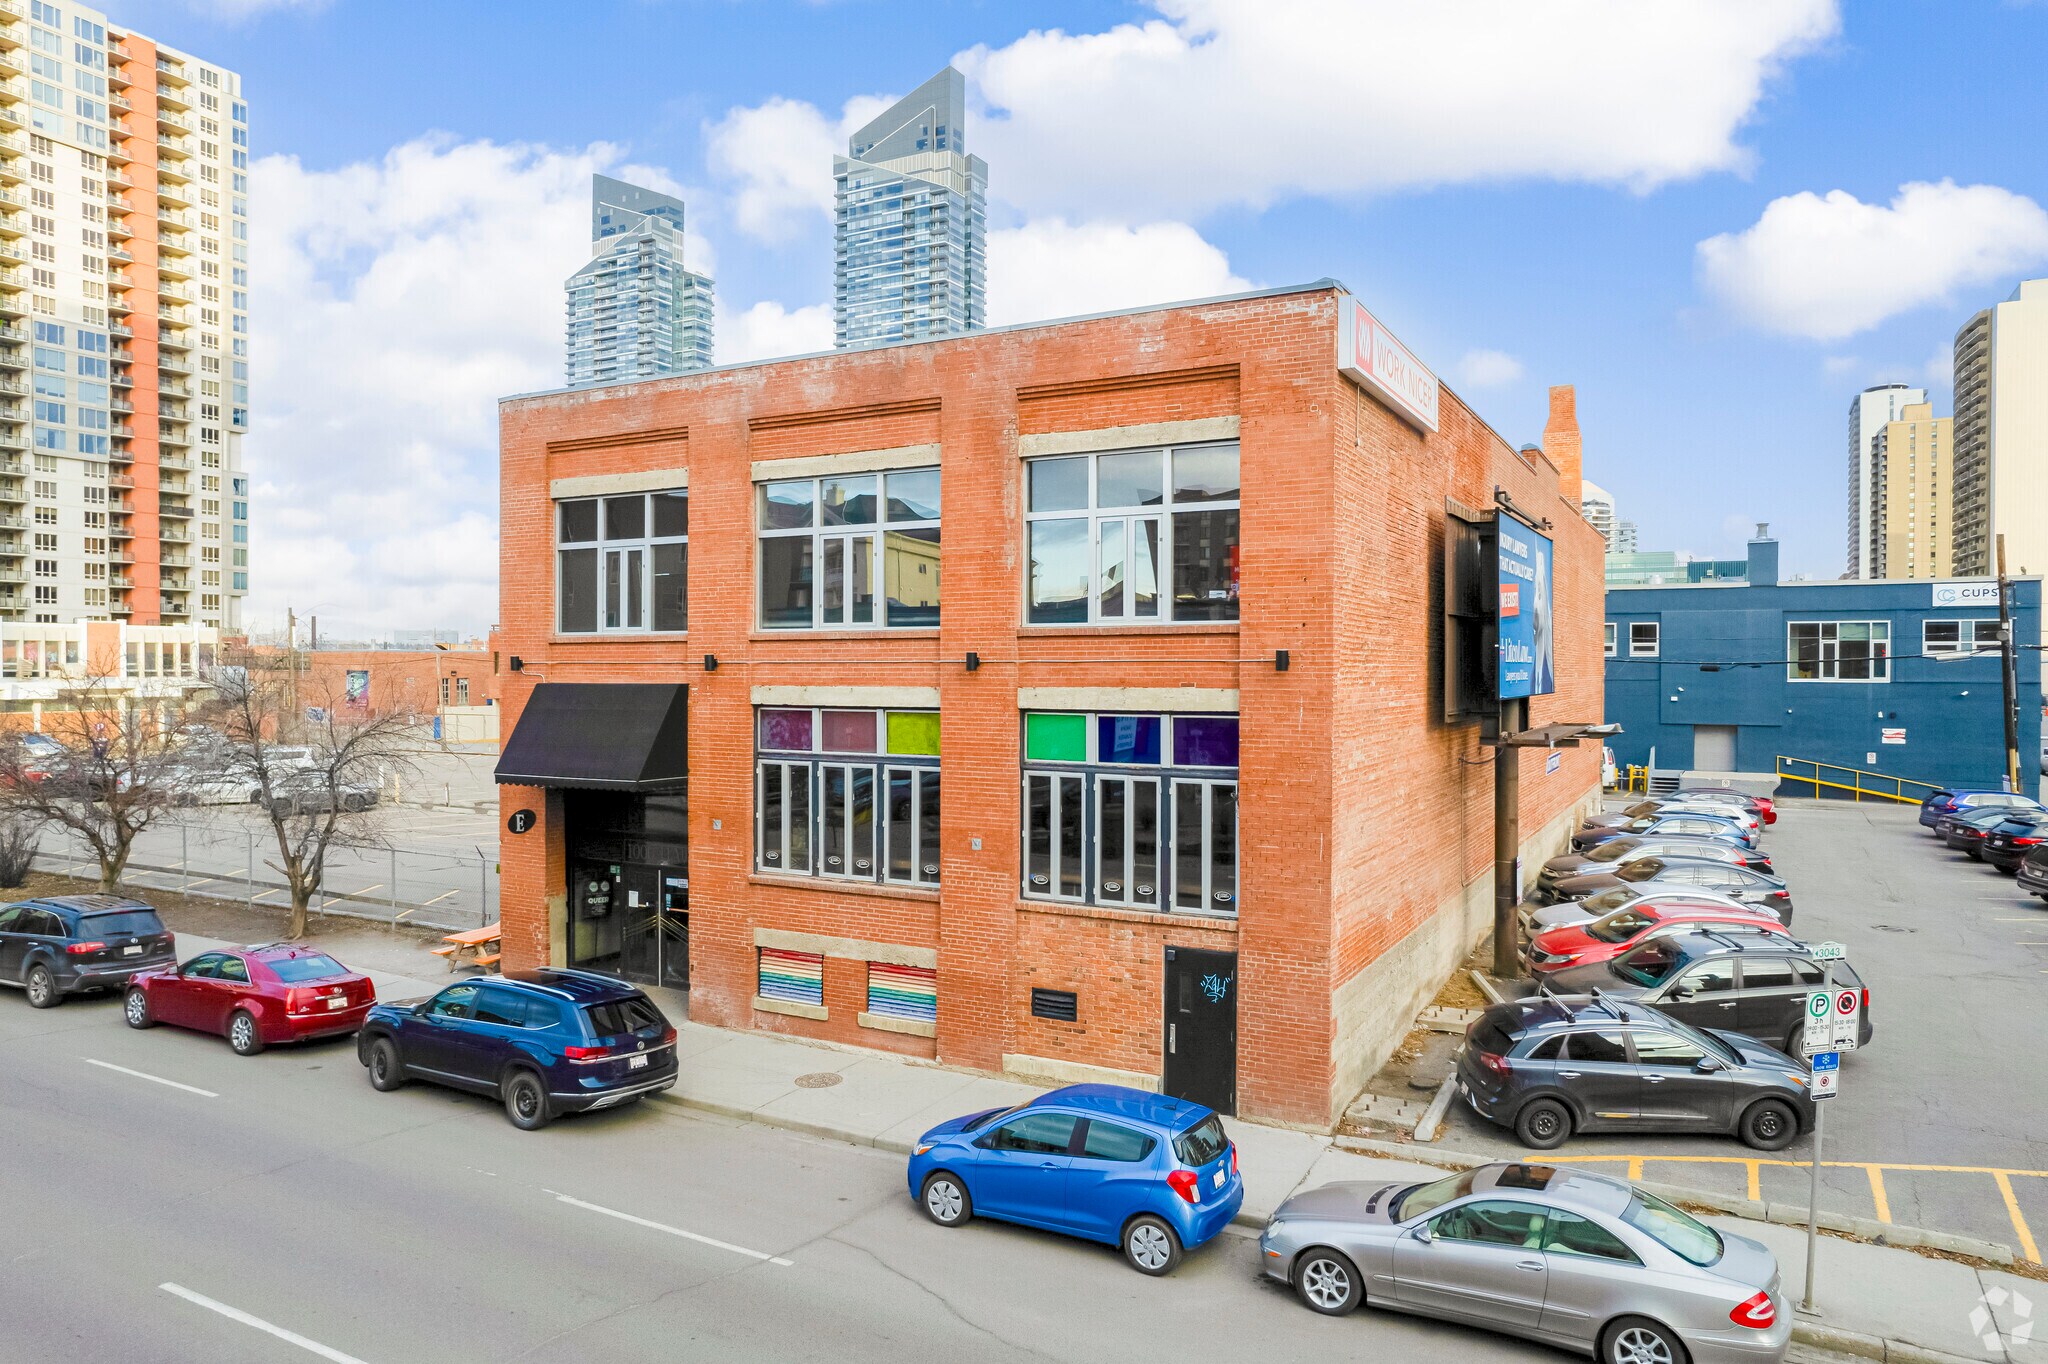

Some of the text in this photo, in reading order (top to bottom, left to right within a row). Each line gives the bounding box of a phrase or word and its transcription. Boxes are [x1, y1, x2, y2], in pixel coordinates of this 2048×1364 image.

[1377, 338, 1433, 412] WORK NICER
[1962, 589, 1998, 597] CUPS
[515, 813, 525, 832] E
[587, 896, 609, 904] QUEER
[1818, 947, 1841, 958] 3043
[1815, 998, 1825, 1013] P
